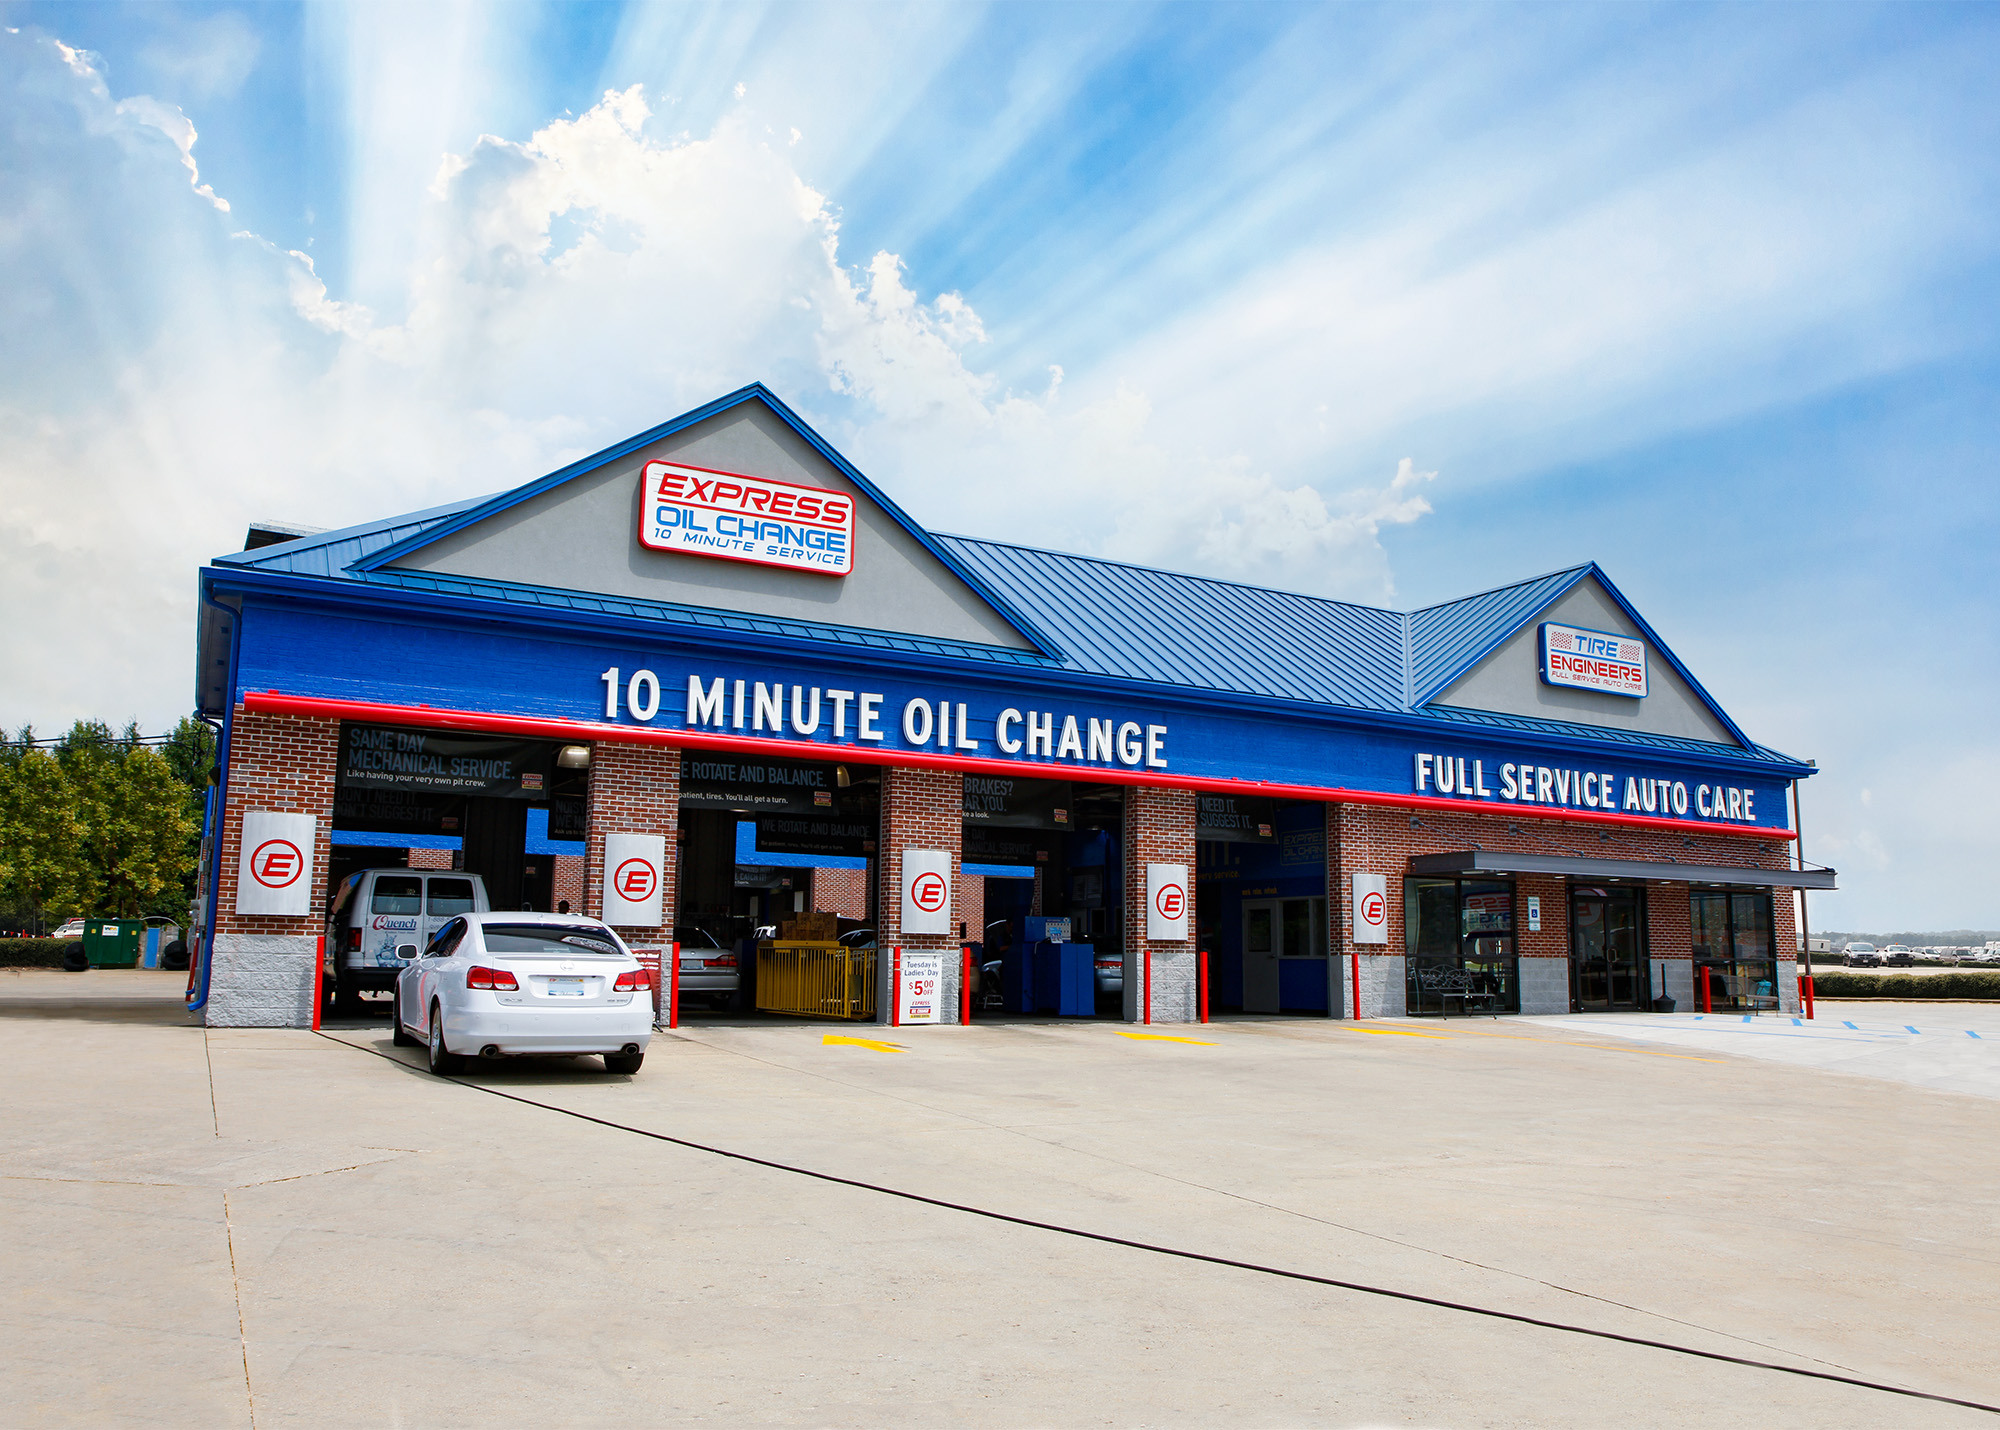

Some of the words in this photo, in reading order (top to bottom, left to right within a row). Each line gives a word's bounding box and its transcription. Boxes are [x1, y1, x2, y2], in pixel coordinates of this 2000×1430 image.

[657, 472, 849, 524] EXPRESS
[656, 505, 708, 532] OIL
[716, 515, 846, 553] CHANGE
[655, 528, 672, 539] 10
[683, 533, 755, 552] MINUTE
[766, 545, 845, 566] SERVICE
[1575, 635, 1618, 657] TIRE
[1551, 654, 1642, 682] ENGINEERS
[1551, 670, 1569, 679] FULL
[1572, 674, 1600, 684] SERVICE
[1603, 679, 1621, 687] AUTO
[1624, 682, 1642, 690] CARE
[601, 666, 661, 721] 10
[687, 674, 884, 741] MINUTE
[903, 697, 978, 750] OIL
[996, 707, 1168, 768] CHANGE
[350, 728, 394, 751] SAME
[397, 732, 427, 753] DAY
[349, 749, 446, 775] MECHANICAL
[450, 757, 516, 780] SERVICE.
[692, 762, 736, 782] ROTATE
[739, 765, 765, 784] AND
[768, 766, 827, 788] BALANCE.
[346, 769, 365, 778] Like
[366, 771, 394, 782] having
[395, 774, 413, 783] your
[415, 776, 434, 785] very
[452, 778, 463, 787] pit
[465, 780, 486, 788] crew.
[964, 776, 1014, 796] BRAKES?
[1414, 752, 1491, 797] FULL
[1499, 762, 1616, 808] SERVICE
[1623, 776, 1688, 815] AUTO
[1694, 784, 1756, 821] CARE
[706, 792, 724, 800] tires.
[725, 793, 743, 801] You'll
[744, 794, 753, 802] all
[964, 795, 980, 810] AR
[981, 796, 1007, 812] YOU.
[1201, 797, 1226, 813] NEED
[778, 819, 808, 834] ROTATE
[810, 823, 829, 836] AND
[1200, 812, 1240, 828] SUGGEST
[1241, 815, 1253, 829] IT.
[373, 915, 417, 930] Quench
[928, 969, 939, 977] Day
